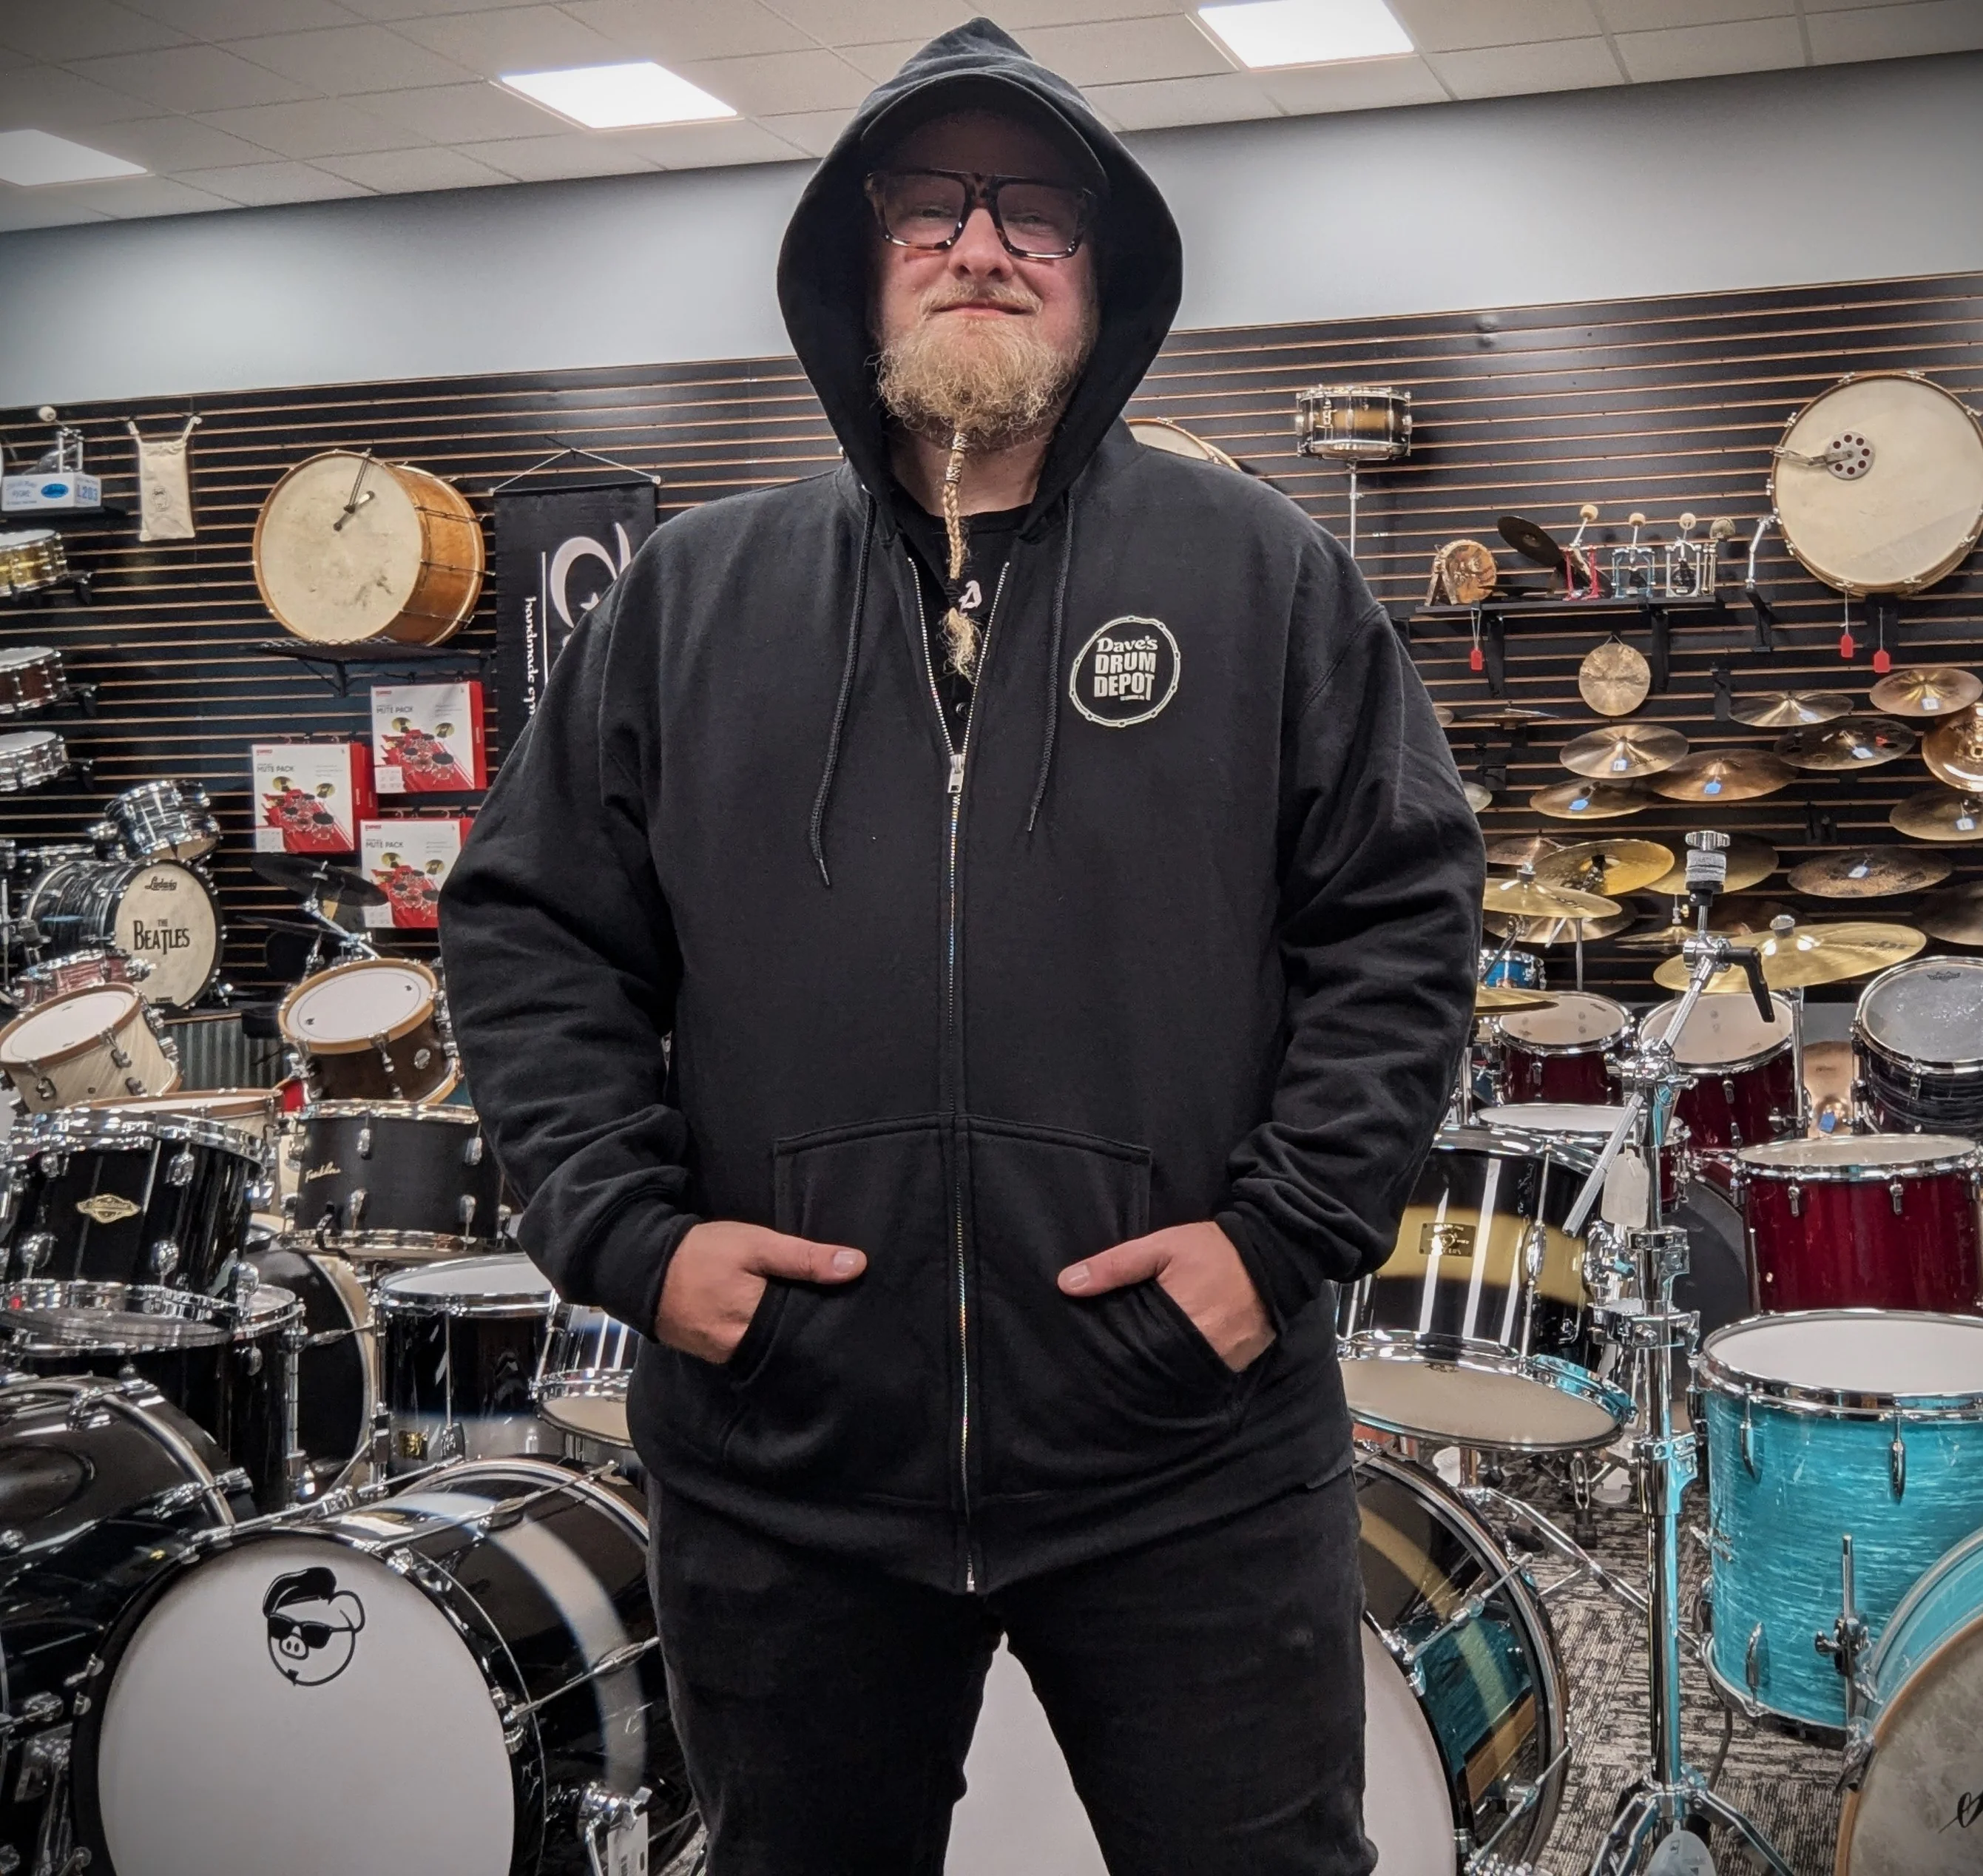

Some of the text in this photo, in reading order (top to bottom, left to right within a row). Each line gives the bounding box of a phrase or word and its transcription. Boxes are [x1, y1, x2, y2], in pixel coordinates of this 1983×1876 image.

[524, 595, 539, 684] handmade
[1095, 635, 1158, 653] Dave's
[1095, 652, 1157, 674] DRUM
[1093, 672, 1155, 701] DEPOT
[144, 876, 178, 891] Ludwig
[157, 918, 169, 927] THE
